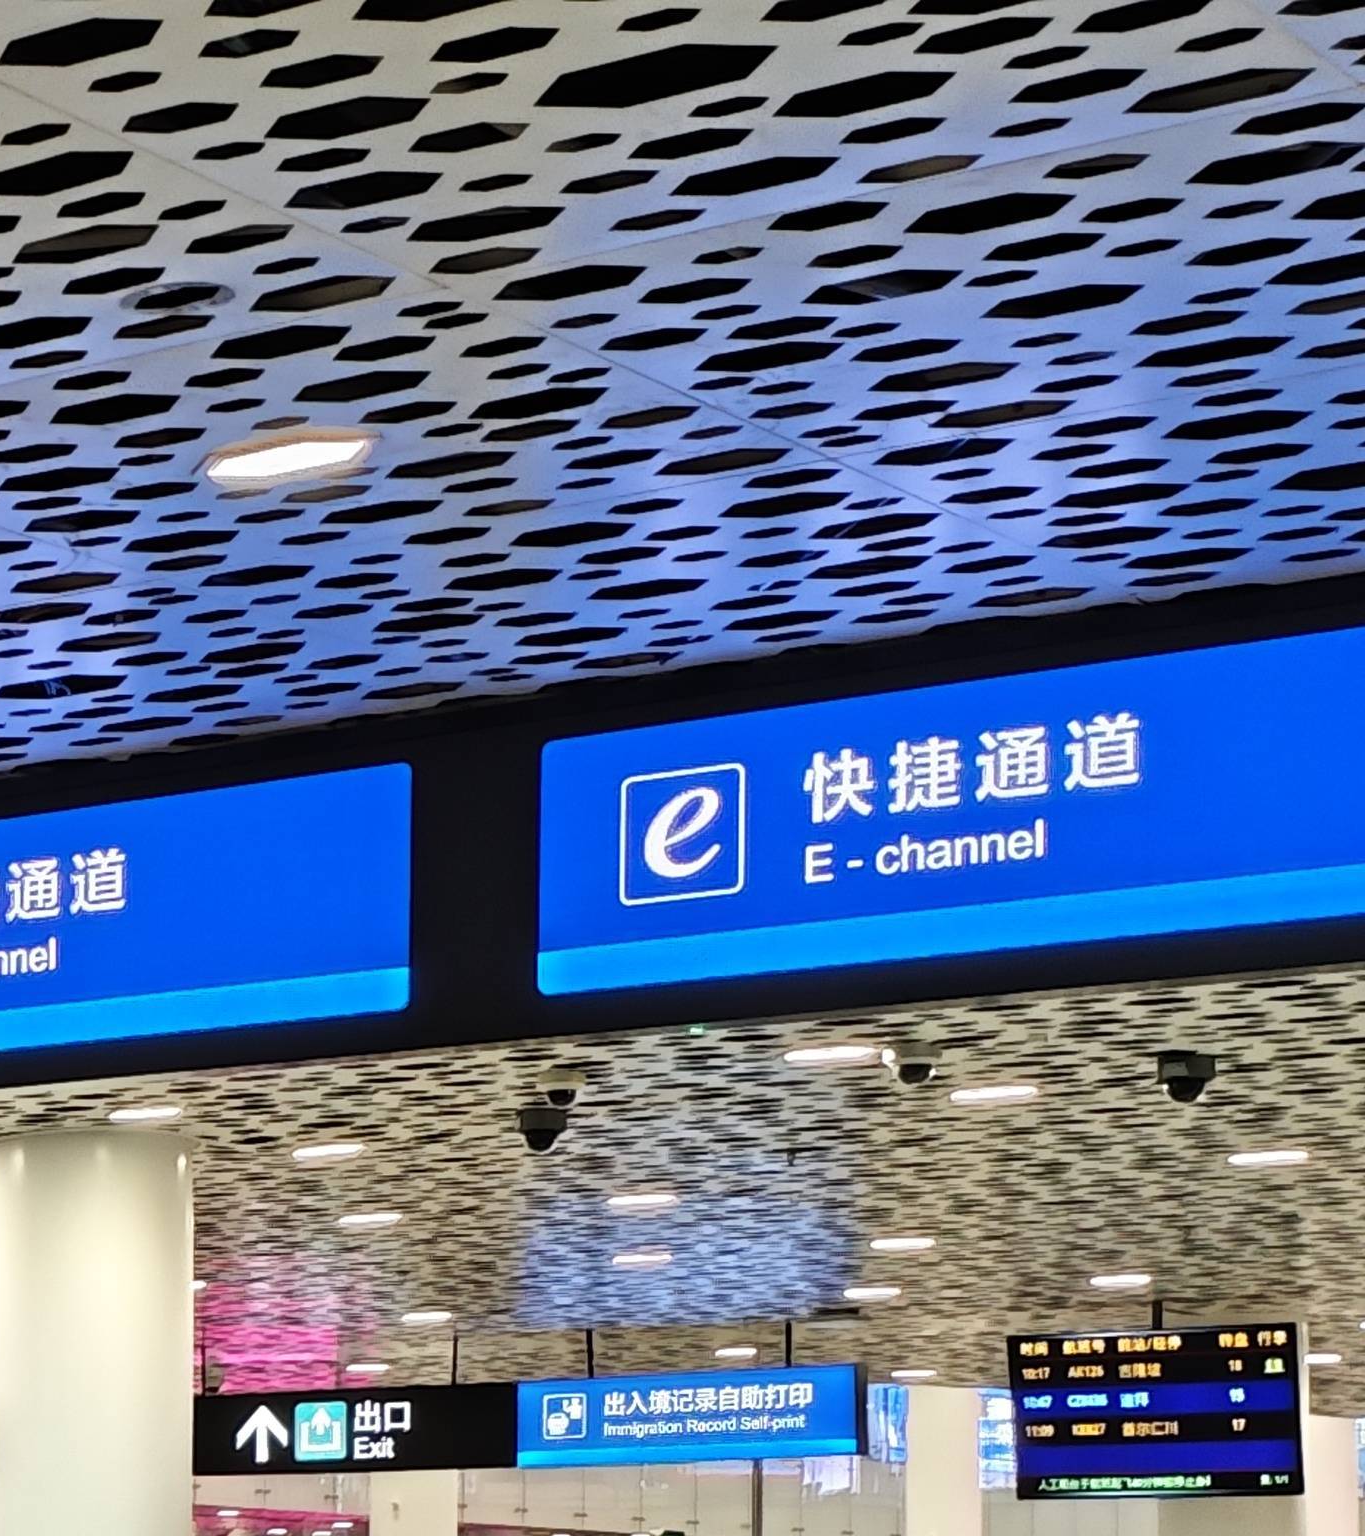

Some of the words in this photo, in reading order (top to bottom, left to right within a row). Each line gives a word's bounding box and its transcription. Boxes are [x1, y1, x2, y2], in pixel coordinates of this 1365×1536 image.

[803, 712, 1140, 823] 快捷通道
[604, 1382, 813, 1416] 出入境记录自助打印
[353, 1400, 411, 1434] 出口
[604, 1422, 683, 1438] Immigration
[354, 1436, 394, 1459] Exit
